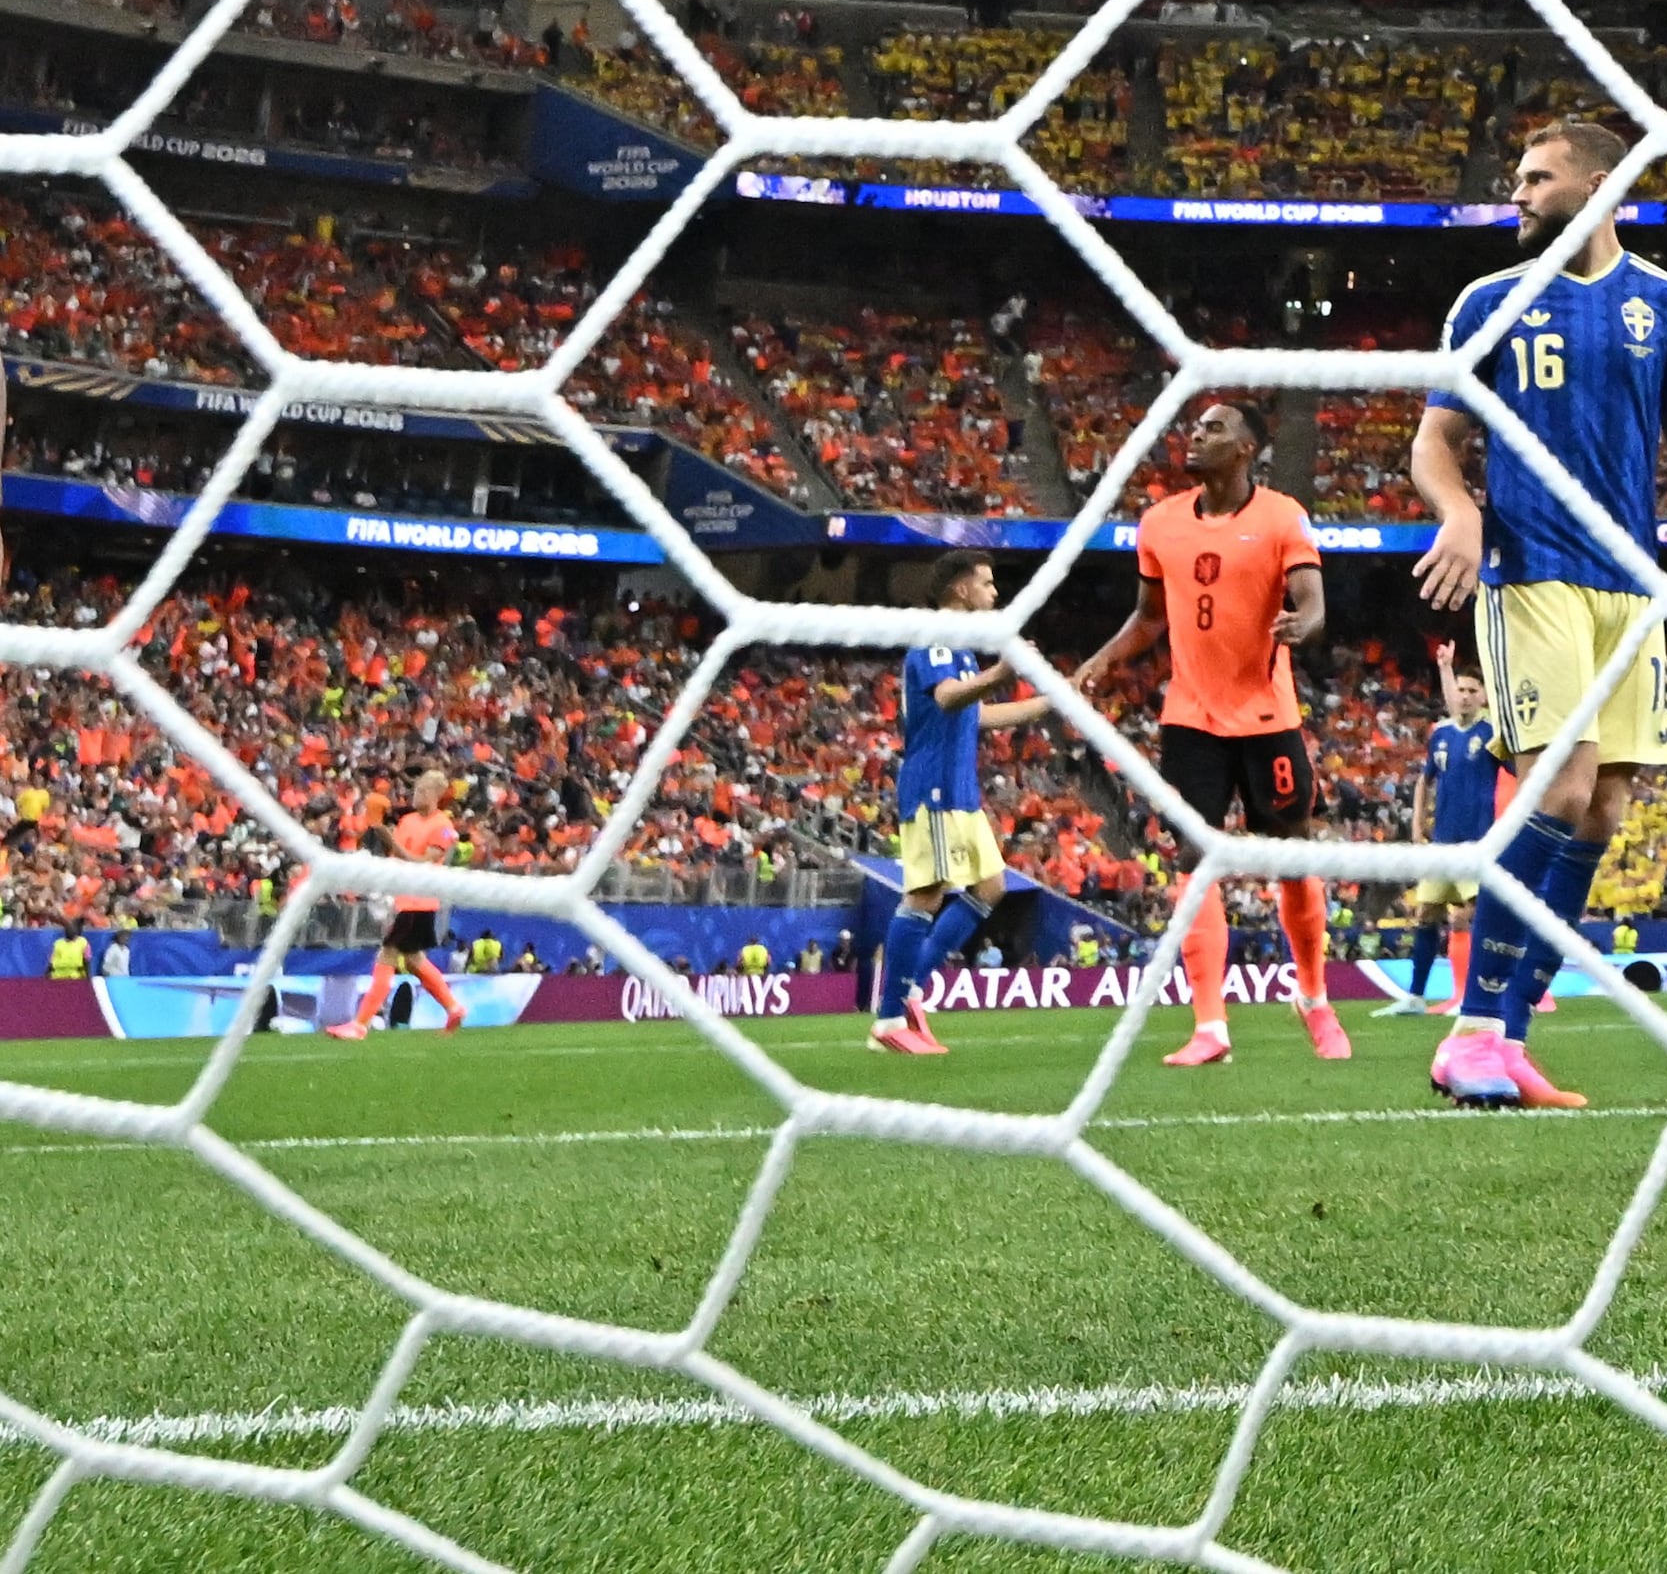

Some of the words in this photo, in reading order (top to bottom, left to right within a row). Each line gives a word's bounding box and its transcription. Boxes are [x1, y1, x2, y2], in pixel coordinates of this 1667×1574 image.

[166, 138, 200, 156] CUP
[904, 188, 1001, 210] HOUSTON
[1213, 203, 1281, 220] WORLD
[1281, 204, 1320, 221] CUP
[1510, 333, 1565, 393] 16
[239, 394, 304, 420] WLD
[306, 403, 342, 424] CUP
[347, 516, 391, 544] FIFA
[393, 521, 472, 550] WORLD
[472, 527, 520, 552] CUP
[1196, 594, 1215, 631] 8
[1272, 755, 1295, 795] 8
[1089, 963, 1299, 1008] AIRAYS
